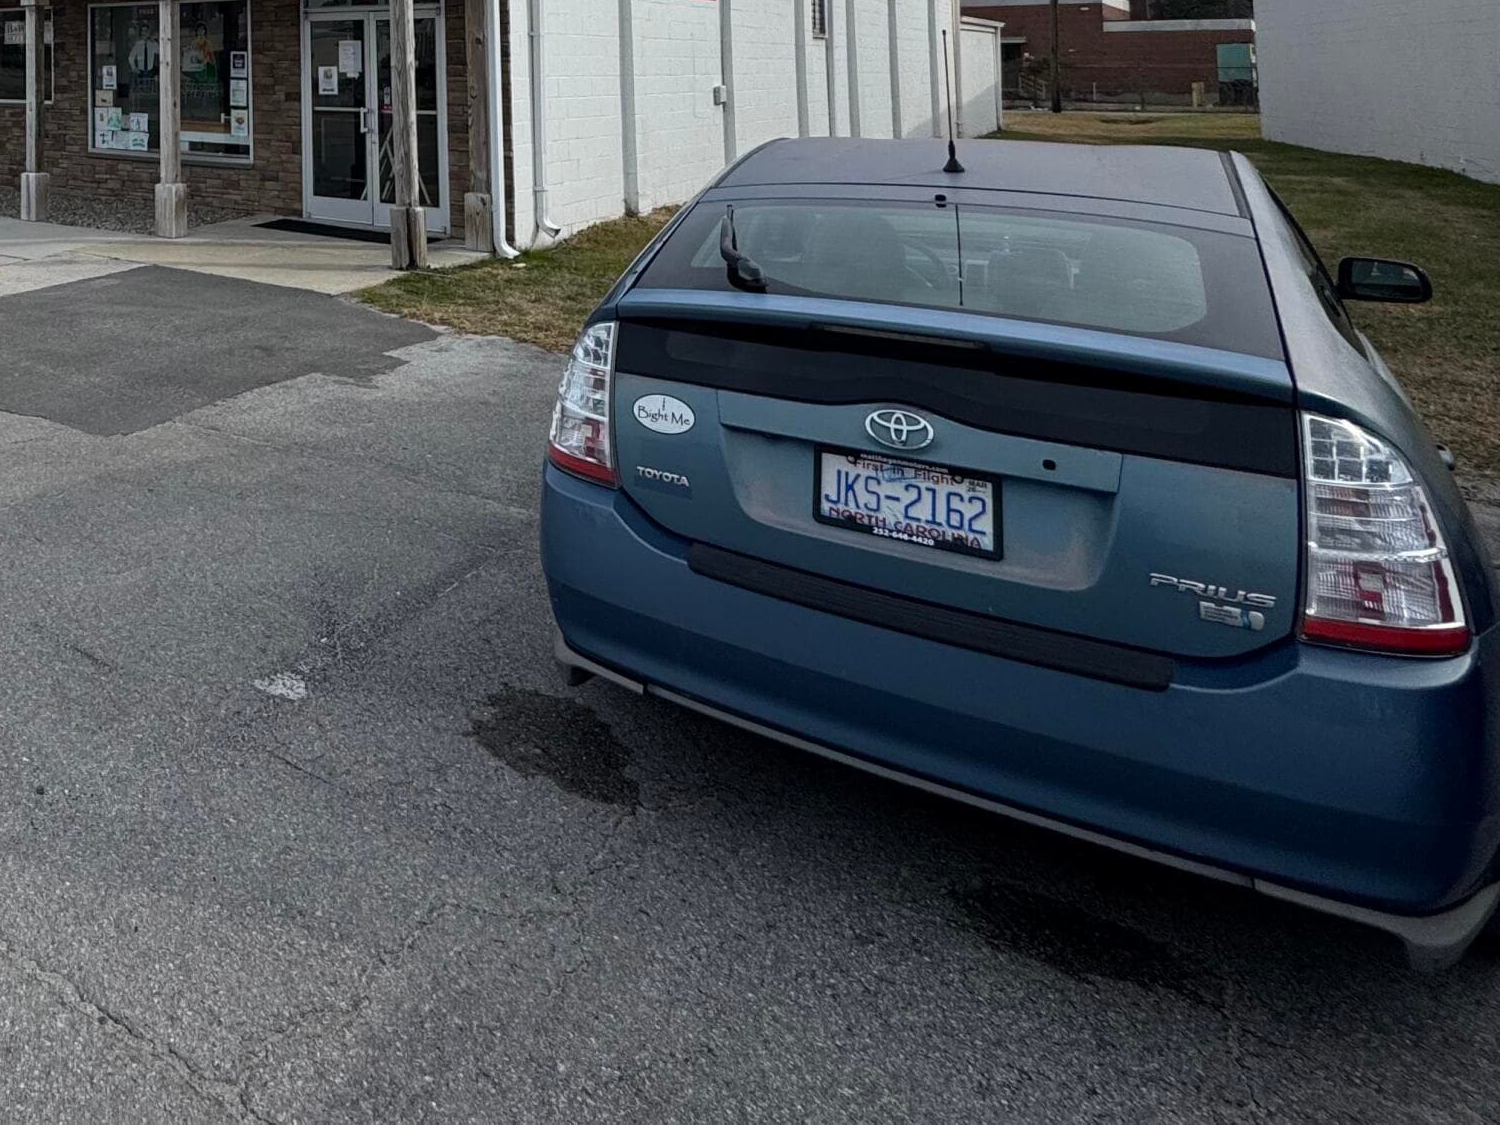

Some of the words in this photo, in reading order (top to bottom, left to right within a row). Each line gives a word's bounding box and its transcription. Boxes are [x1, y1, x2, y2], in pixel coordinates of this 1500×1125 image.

[637, 405, 668, 423] Bight
[670, 411, 691, 426] Me
[636, 465, 690, 487] TOYOTA
[824, 469, 987, 535] JKS-2162
[828, 506, 887, 527] NORTH
[1149, 572, 1277, 608] PRIUS
